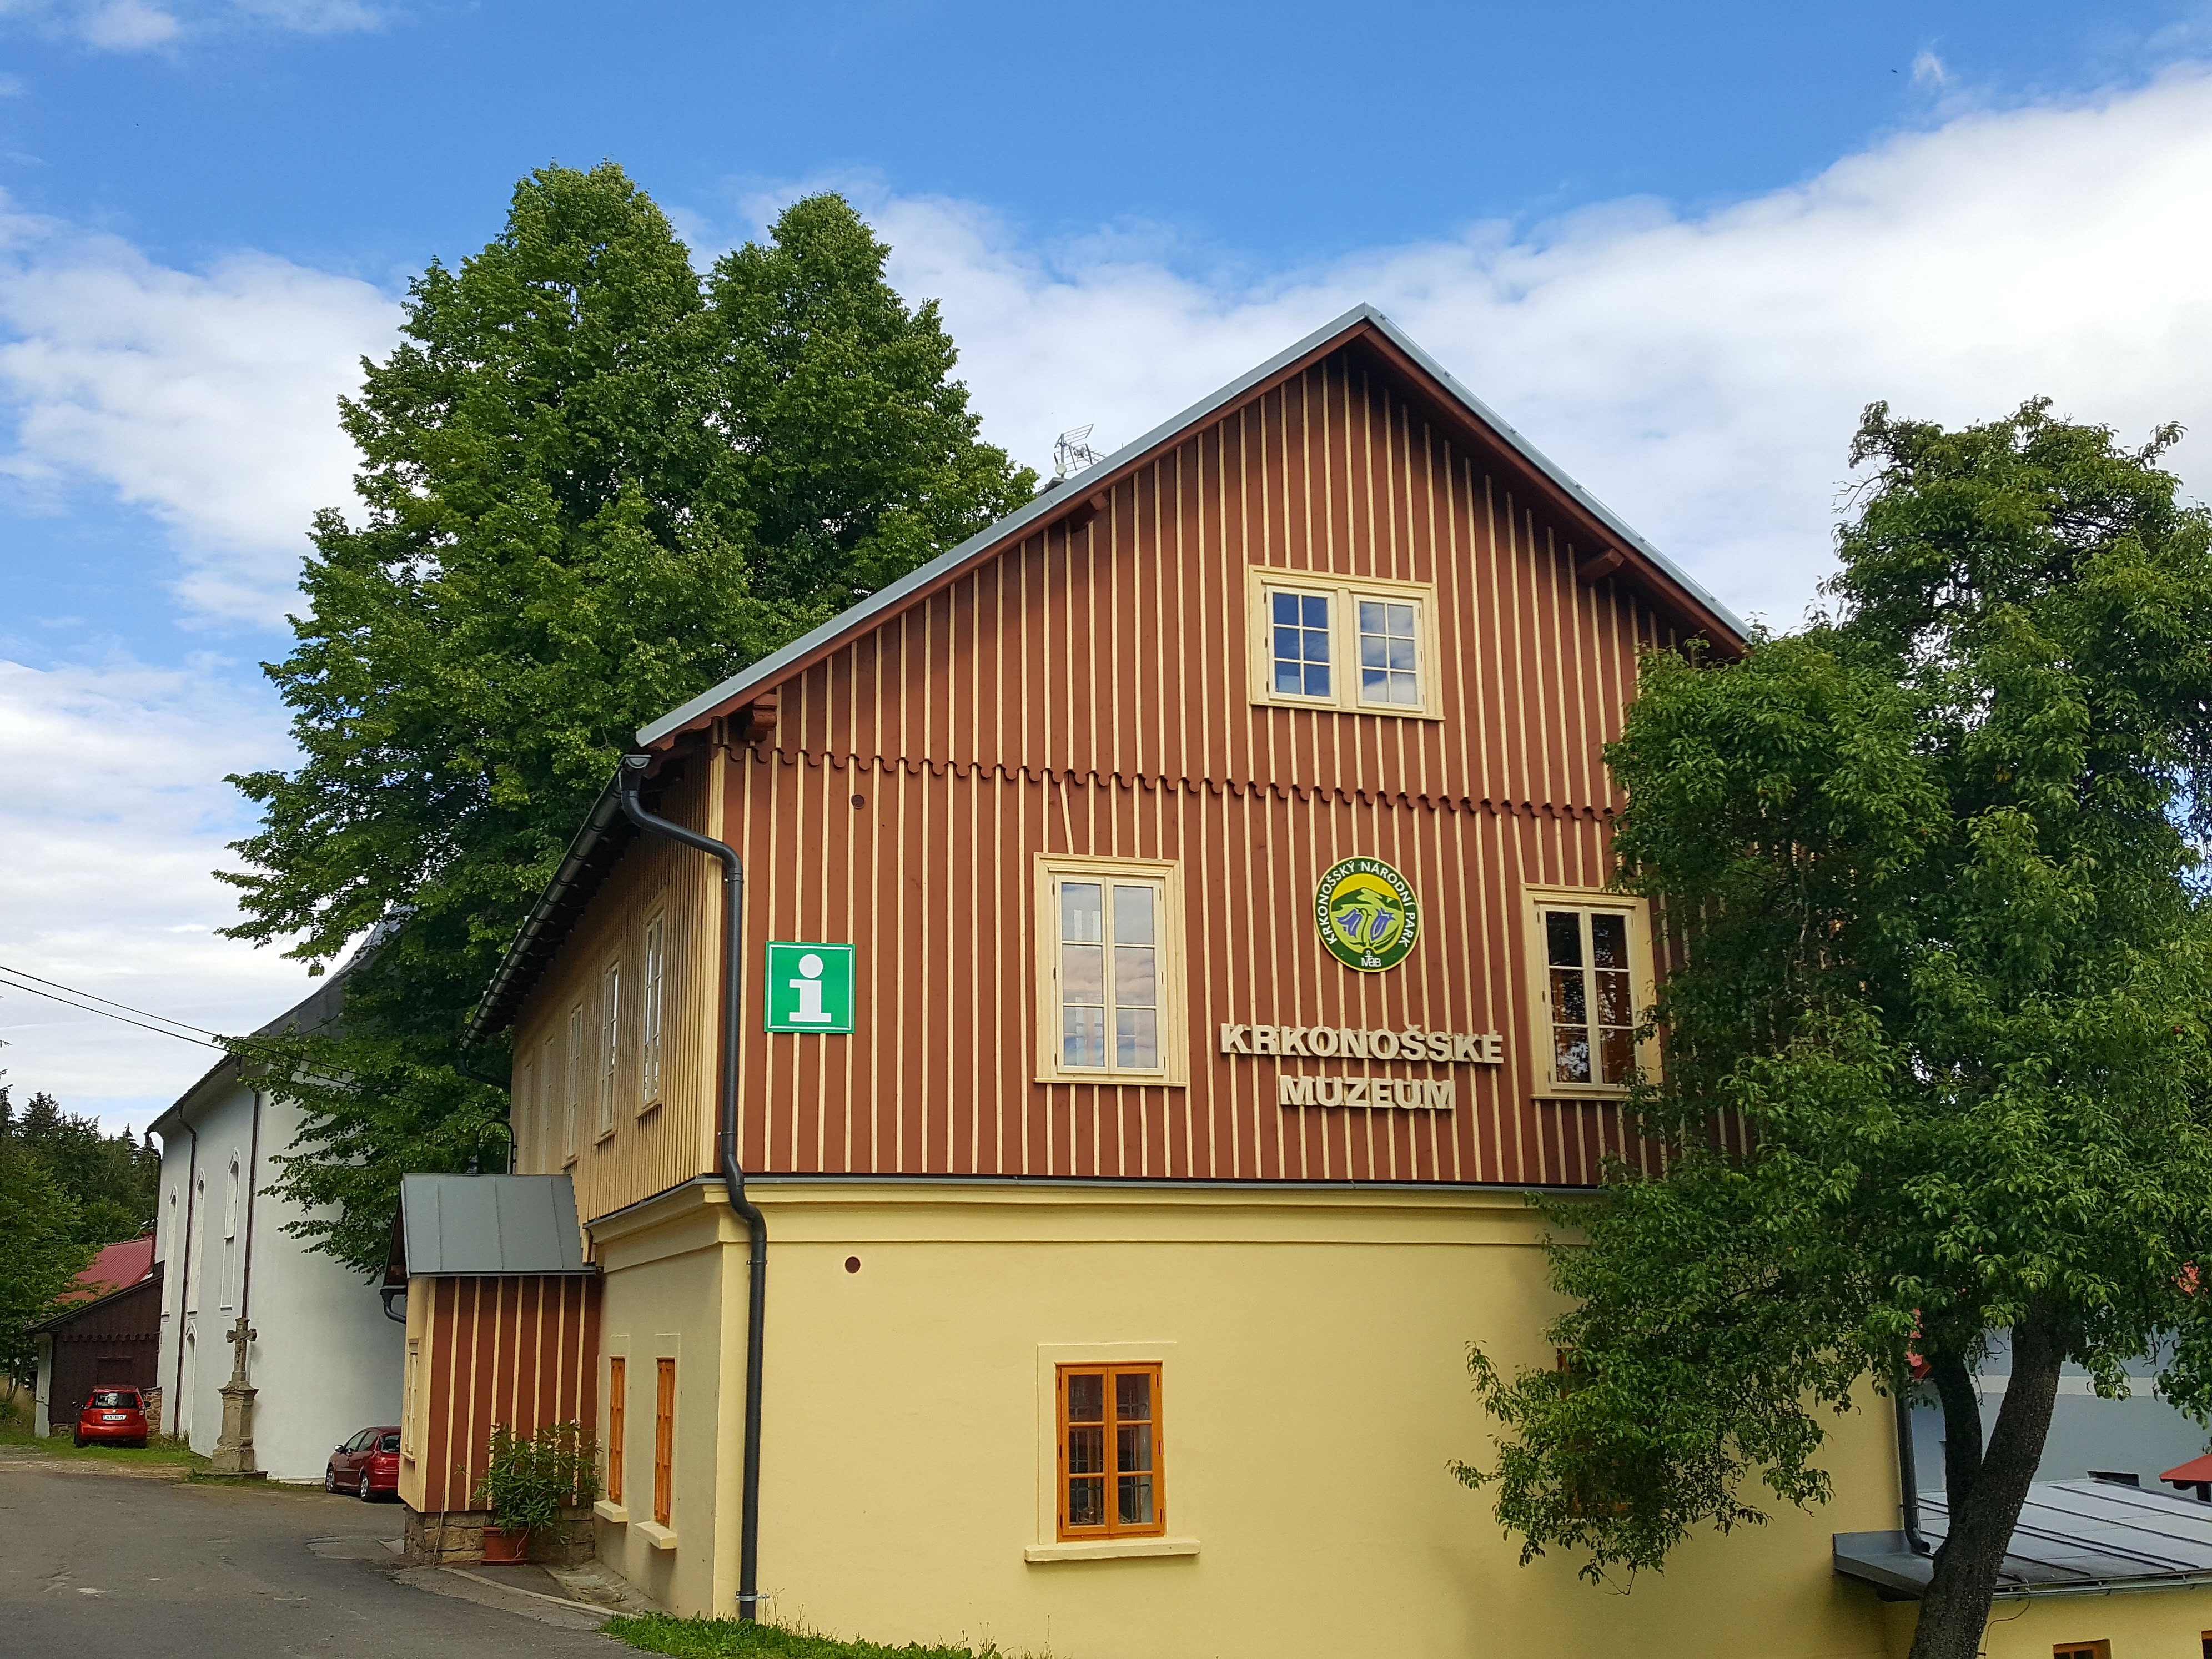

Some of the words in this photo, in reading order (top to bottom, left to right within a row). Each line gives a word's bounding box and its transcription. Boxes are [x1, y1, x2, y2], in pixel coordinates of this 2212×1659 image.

[1318, 861, 1355, 944] KRKONOŠSKÝ
[1361, 862, 1415, 907] NÁRODNÍ
[1399, 912, 1415, 947] PARK
[1220, 1023, 1504, 1063] KRKONOŠSKÉ
[1279, 1075, 1455, 1109] MUZEUM
